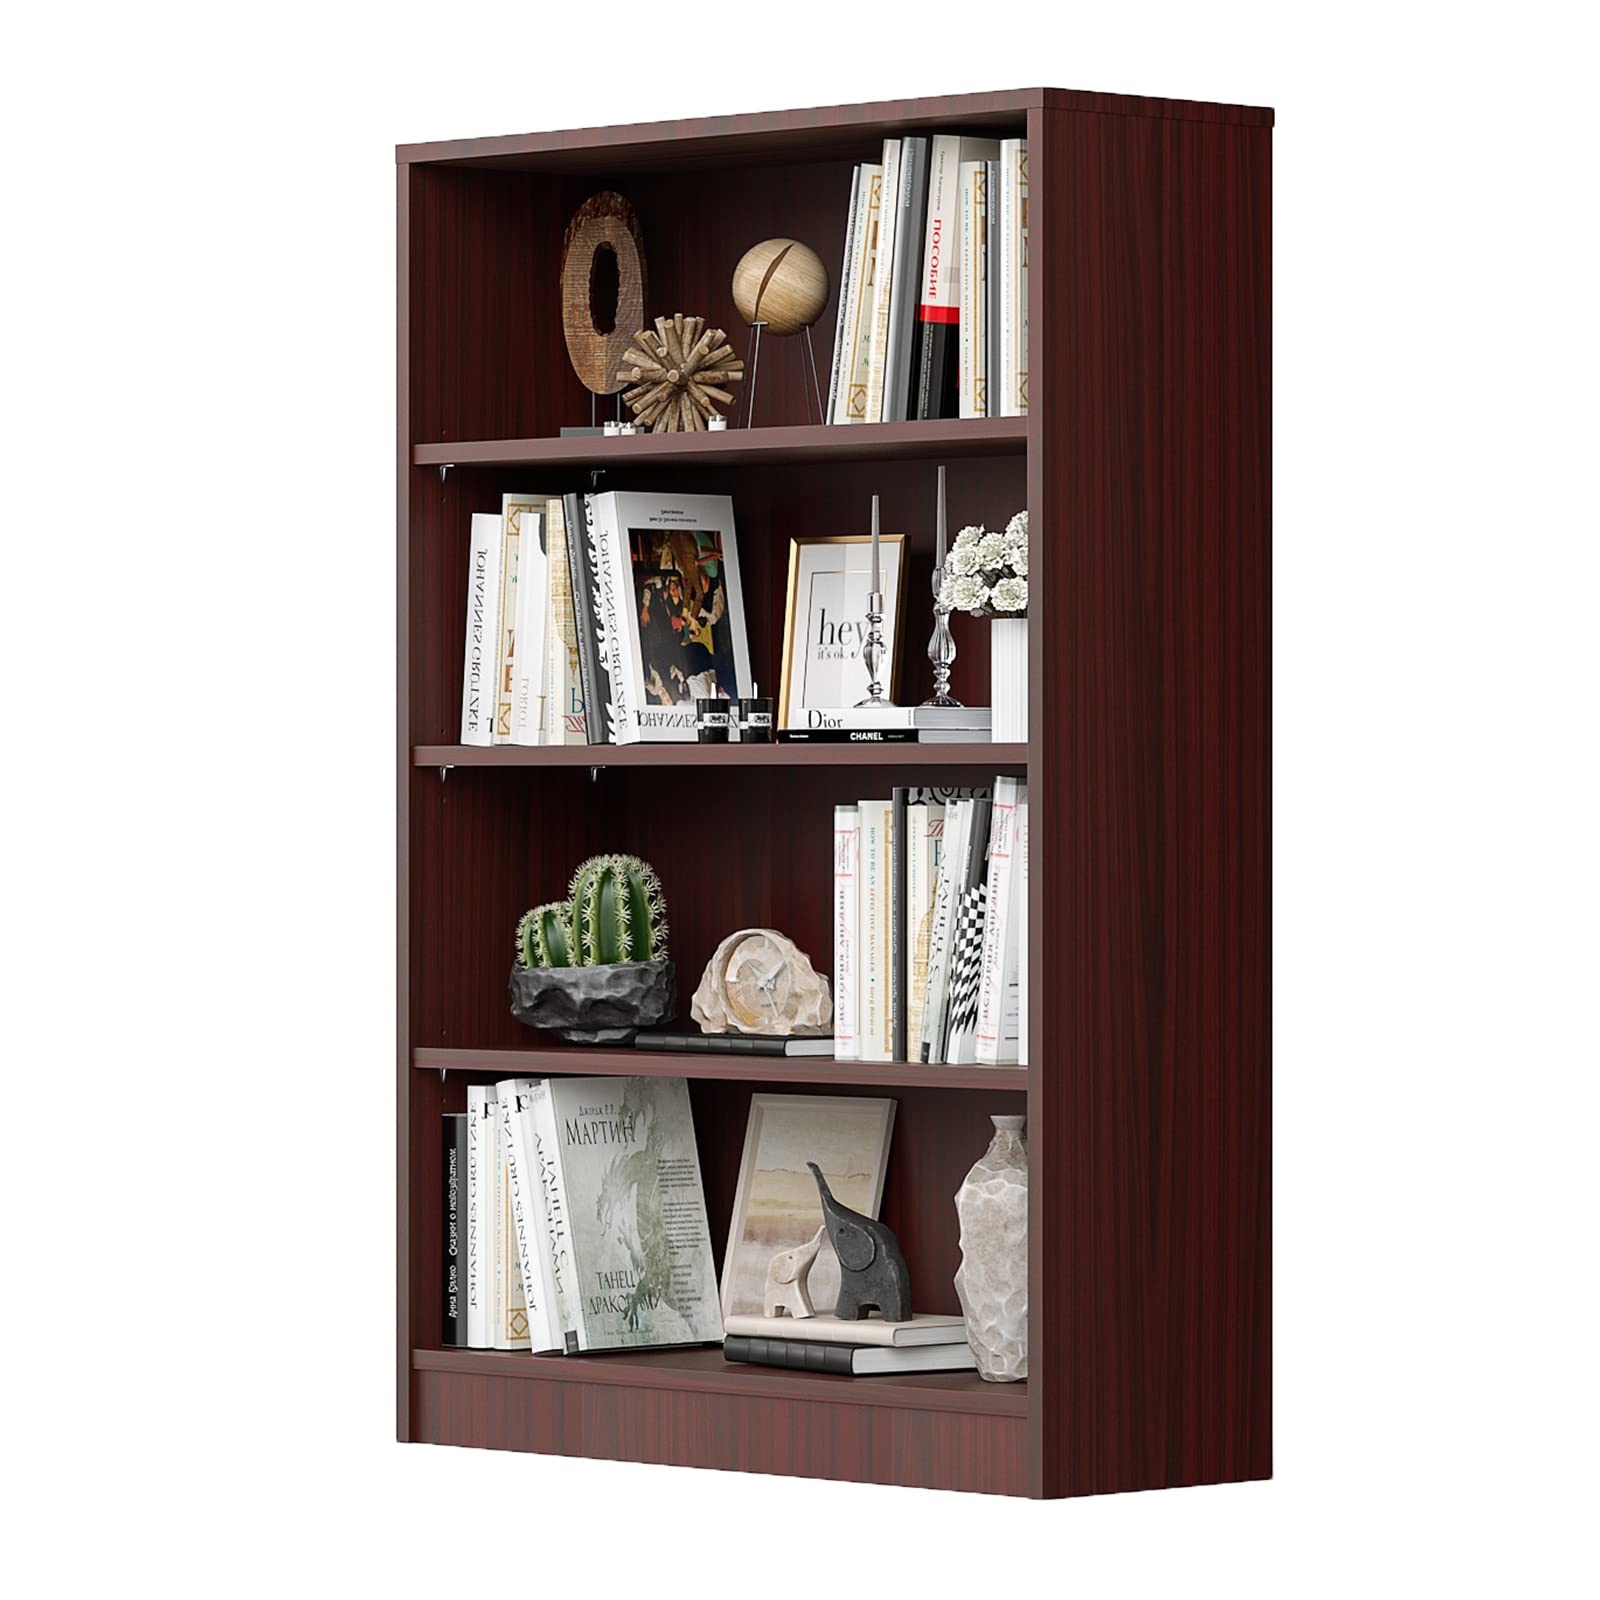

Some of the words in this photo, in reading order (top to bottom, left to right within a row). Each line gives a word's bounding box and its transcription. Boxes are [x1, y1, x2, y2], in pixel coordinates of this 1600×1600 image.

[928, 219, 942, 300] ПОСОБИЕ
[817, 608, 868, 659] hey
[808, 710, 843, 729] Dior
[849, 731, 884, 742] CHANEL
[565, 1117, 636, 1146] МАРТИН
[596, 1270, 636, 1290] ТАНЕЦ
